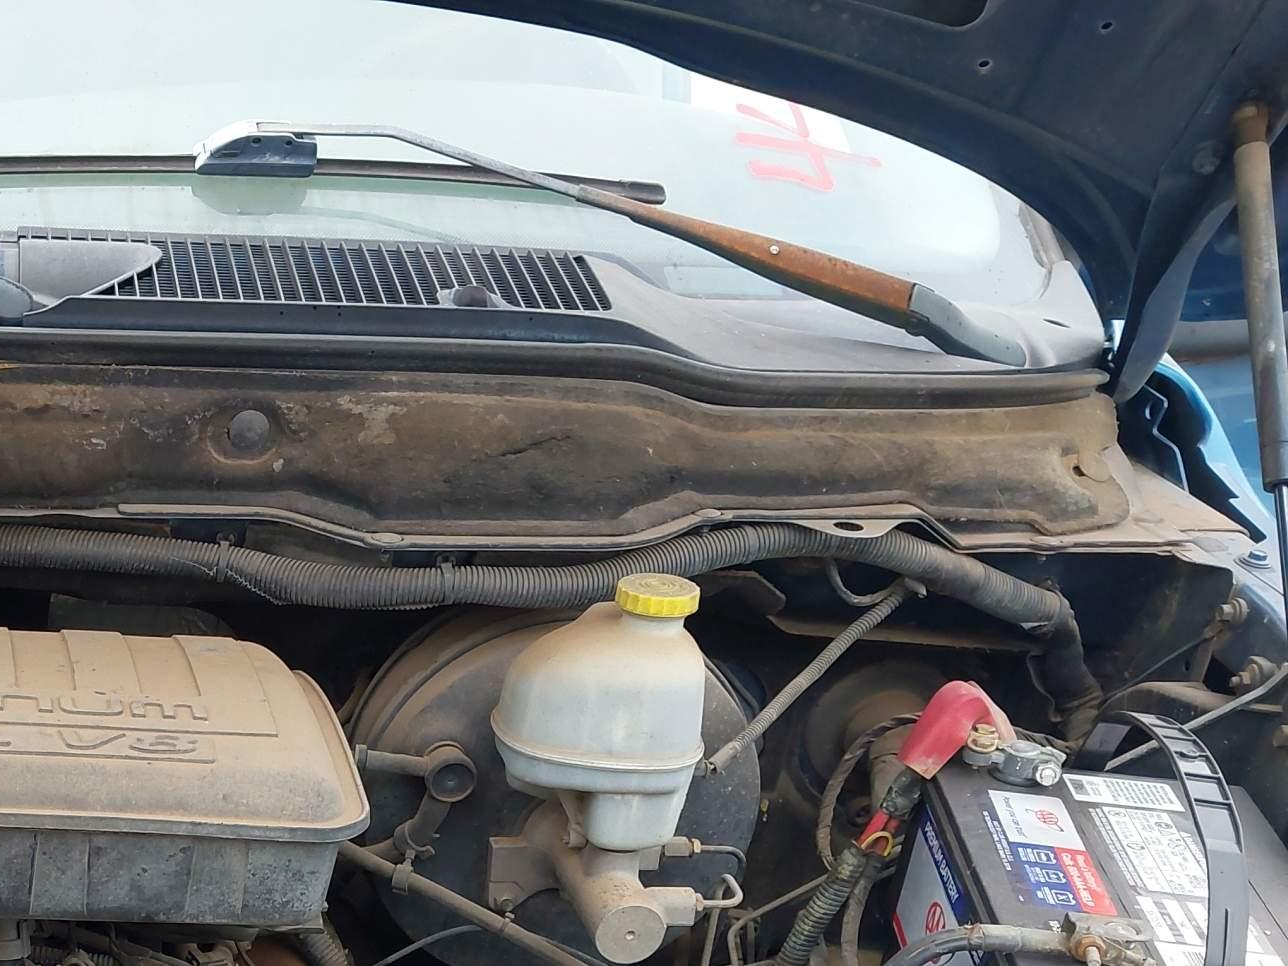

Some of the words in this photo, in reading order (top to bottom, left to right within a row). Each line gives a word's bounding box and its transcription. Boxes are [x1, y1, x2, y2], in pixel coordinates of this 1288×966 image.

[57, 730, 199, 755] V8
[924, 820, 944, 866] PREMIUM
[938, 860, 960, 904] BATTERY
